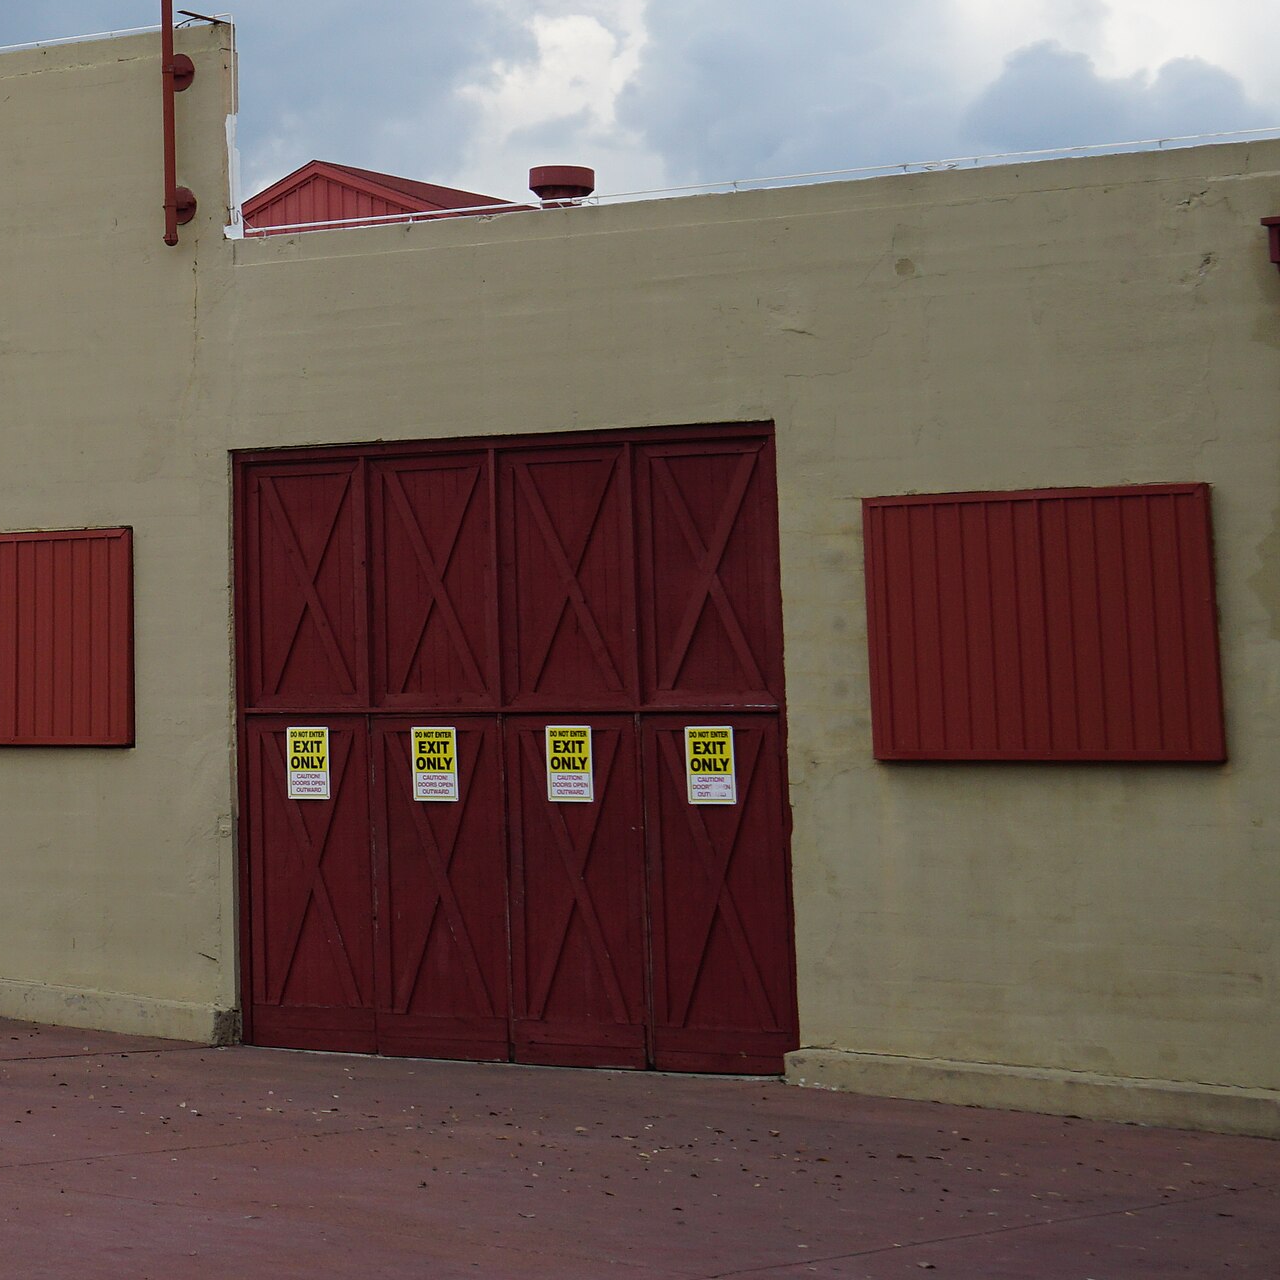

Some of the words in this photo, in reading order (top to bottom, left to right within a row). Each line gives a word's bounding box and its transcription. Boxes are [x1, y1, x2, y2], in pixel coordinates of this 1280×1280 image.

[293, 740, 322, 753] EXIT
[418, 741, 449, 754] EXIT
[553, 740, 584, 753] EXIT
[693, 741, 726, 754] EXIT
[291, 756, 325, 769] ONLY
[416, 756, 453, 770] ONLY
[550, 756, 588, 770] ONLY
[690, 758, 729, 772] ONLY
